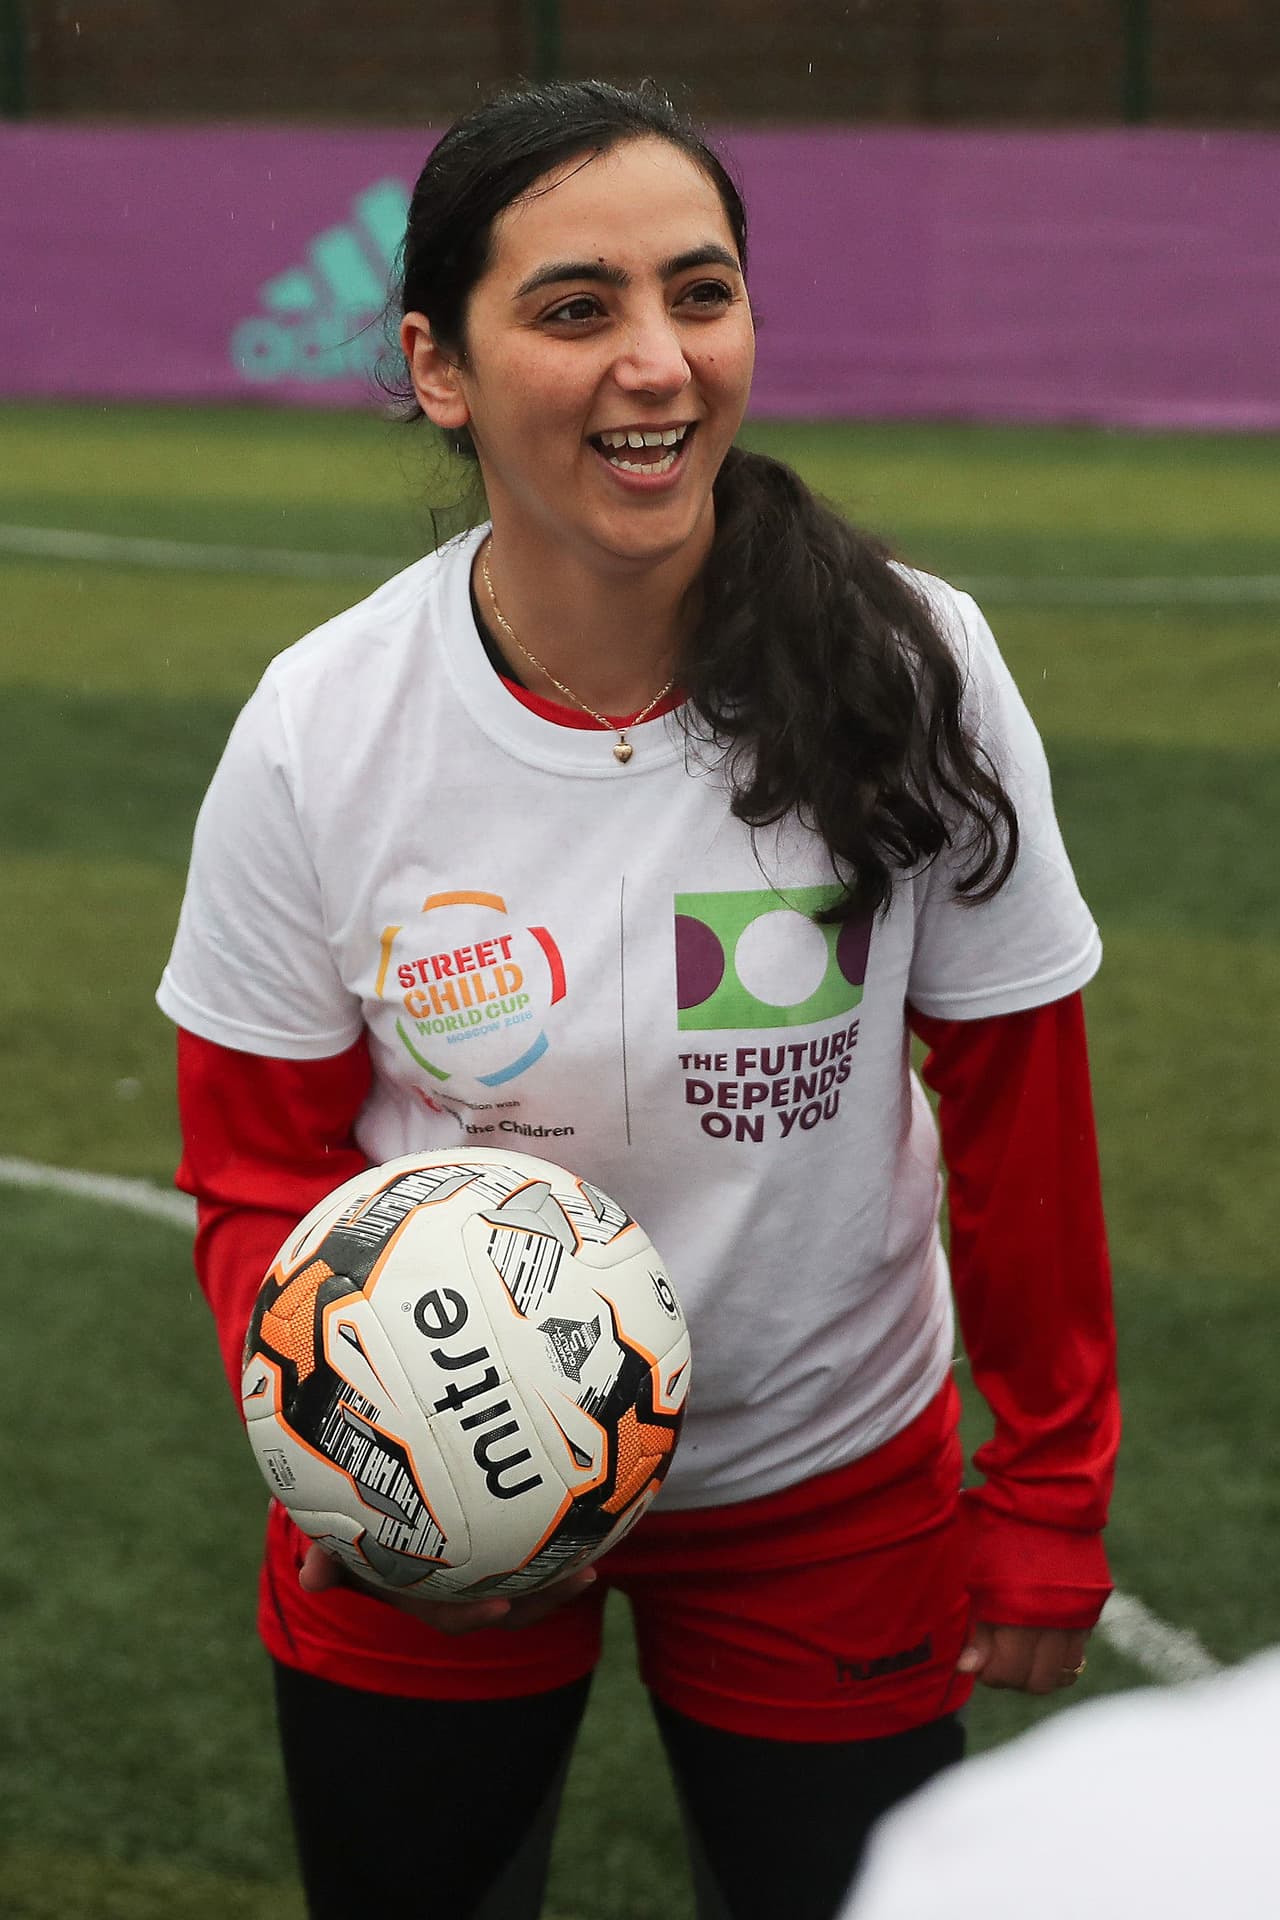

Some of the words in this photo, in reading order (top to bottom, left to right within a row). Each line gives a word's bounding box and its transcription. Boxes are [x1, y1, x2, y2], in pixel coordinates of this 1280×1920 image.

[231, 310, 406, 382] adid
[397, 934, 512, 988] STREET
[403, 962, 523, 1018] CHILD
[415, 1009, 482, 1036] WORLD
[485, 993, 530, 1019] CUP
[446, 1021, 500, 1044] MOSCOW
[678, 1053, 728, 1071] THE
[736, 1019, 860, 1077] FUTURE
[685, 1054, 853, 1109] DEPENDS
[466, 1123, 495, 1135] the
[499, 1120, 575, 1137] Children
[701, 1111, 764, 1142] ON
[778, 1089, 840, 1138] YOU
[414, 1288, 543, 1499] mitre
